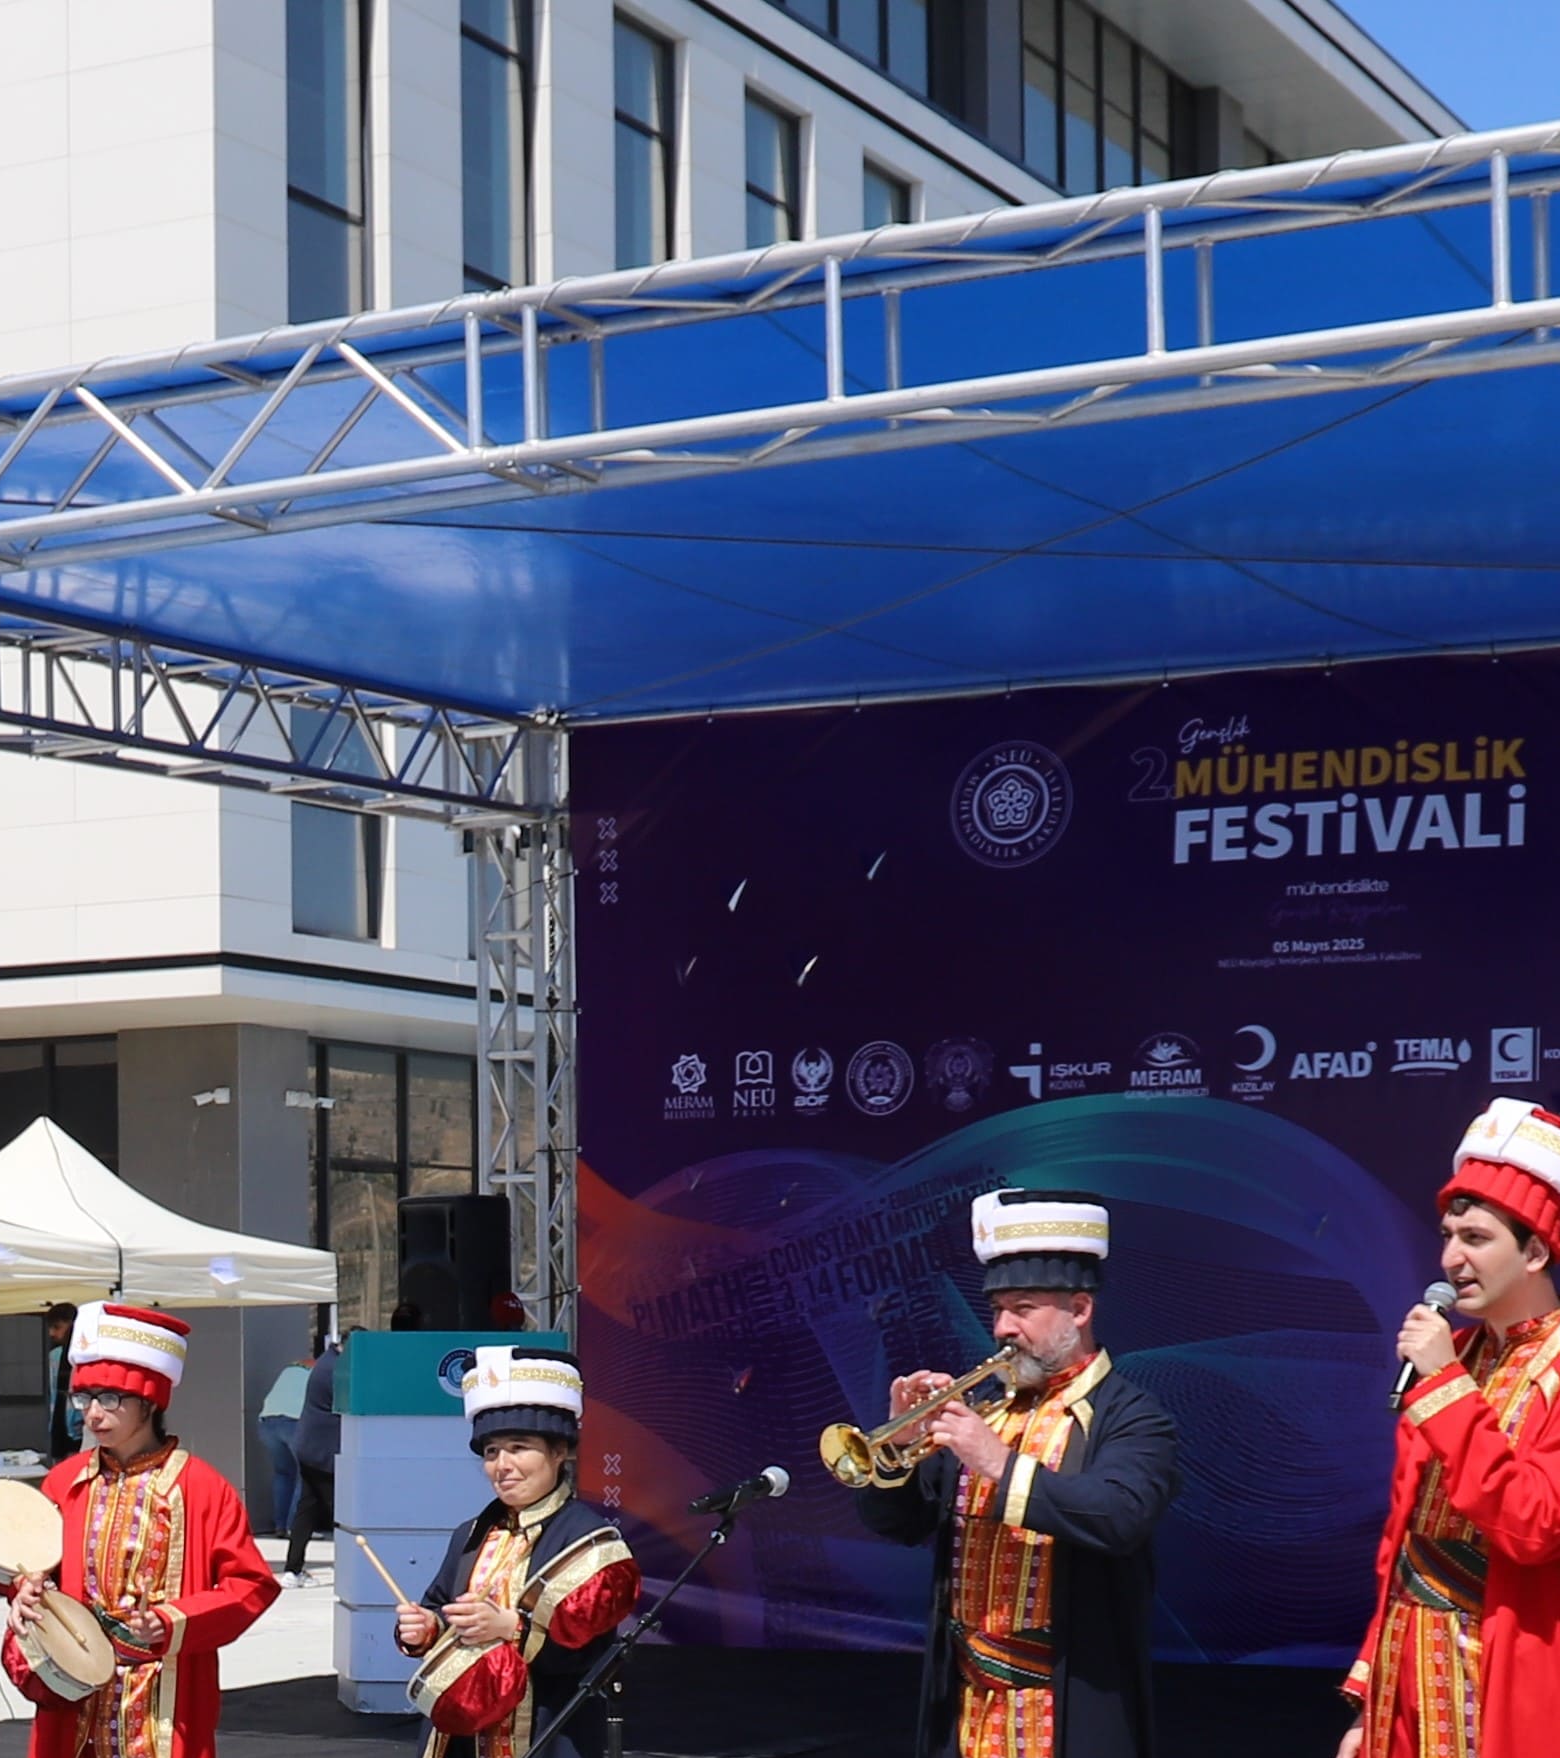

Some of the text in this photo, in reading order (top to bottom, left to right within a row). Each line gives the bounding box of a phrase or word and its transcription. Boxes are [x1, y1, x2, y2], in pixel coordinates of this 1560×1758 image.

[1286, 878, 1389, 896] mühendislikte
[1272, 937, 1365, 955] 05 Mayıs 2025
[1393, 1038, 1455, 1061] TEMA
[1288, 1051, 1373, 1079] AFAD
[1130, 1069, 1202, 1087] MERAM
[664, 1095, 714, 1109] MERAM
[769, 1211, 889, 1278] CONSTANT
[659, 1266, 749, 1338] MATH
